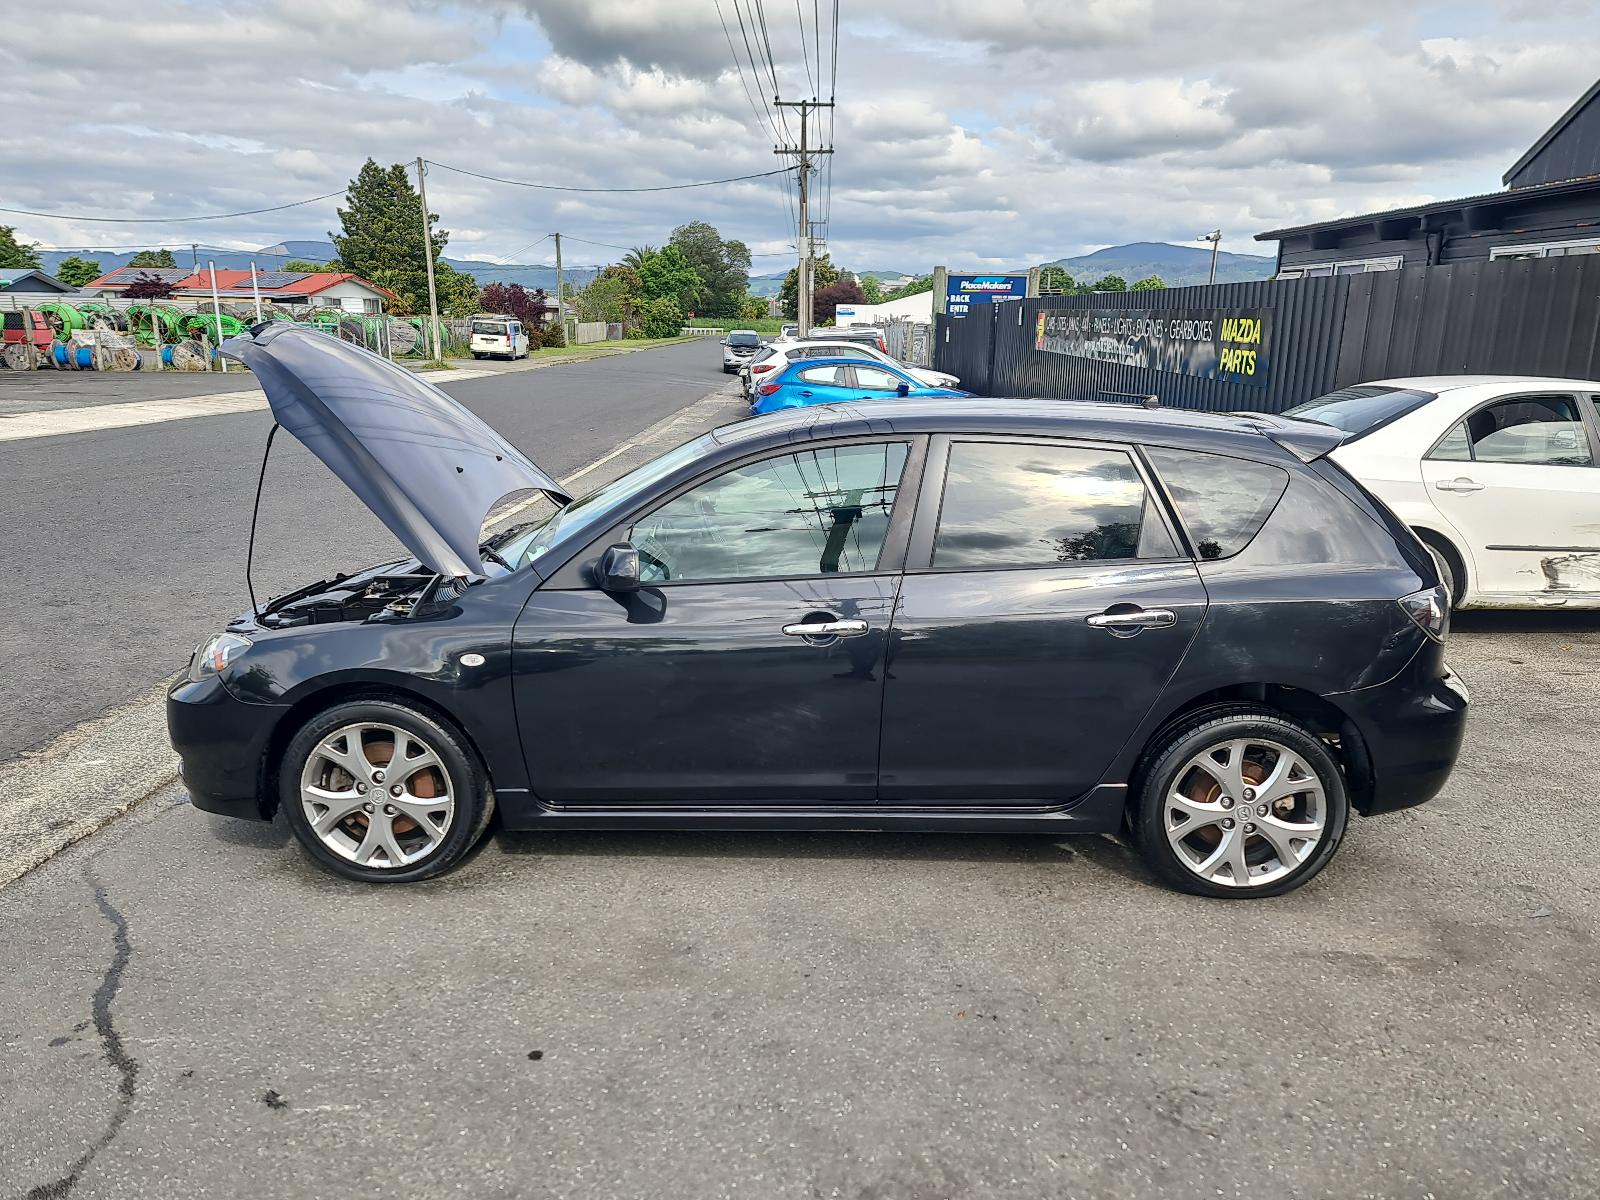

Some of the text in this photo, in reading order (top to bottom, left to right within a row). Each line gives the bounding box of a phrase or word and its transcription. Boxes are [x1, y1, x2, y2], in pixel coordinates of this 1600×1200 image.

[960, 281, 1012, 289] PlaceMakers
[950, 295, 971, 303] BACK
[1113, 318, 1133, 335] LIGHTS
[1135, 319, 1164, 338] ENGINES
[1169, 320, 1213, 342] GEARBOXES
[1220, 318, 1261, 344] MAZDA
[1219, 348, 1257, 376] PARTS
